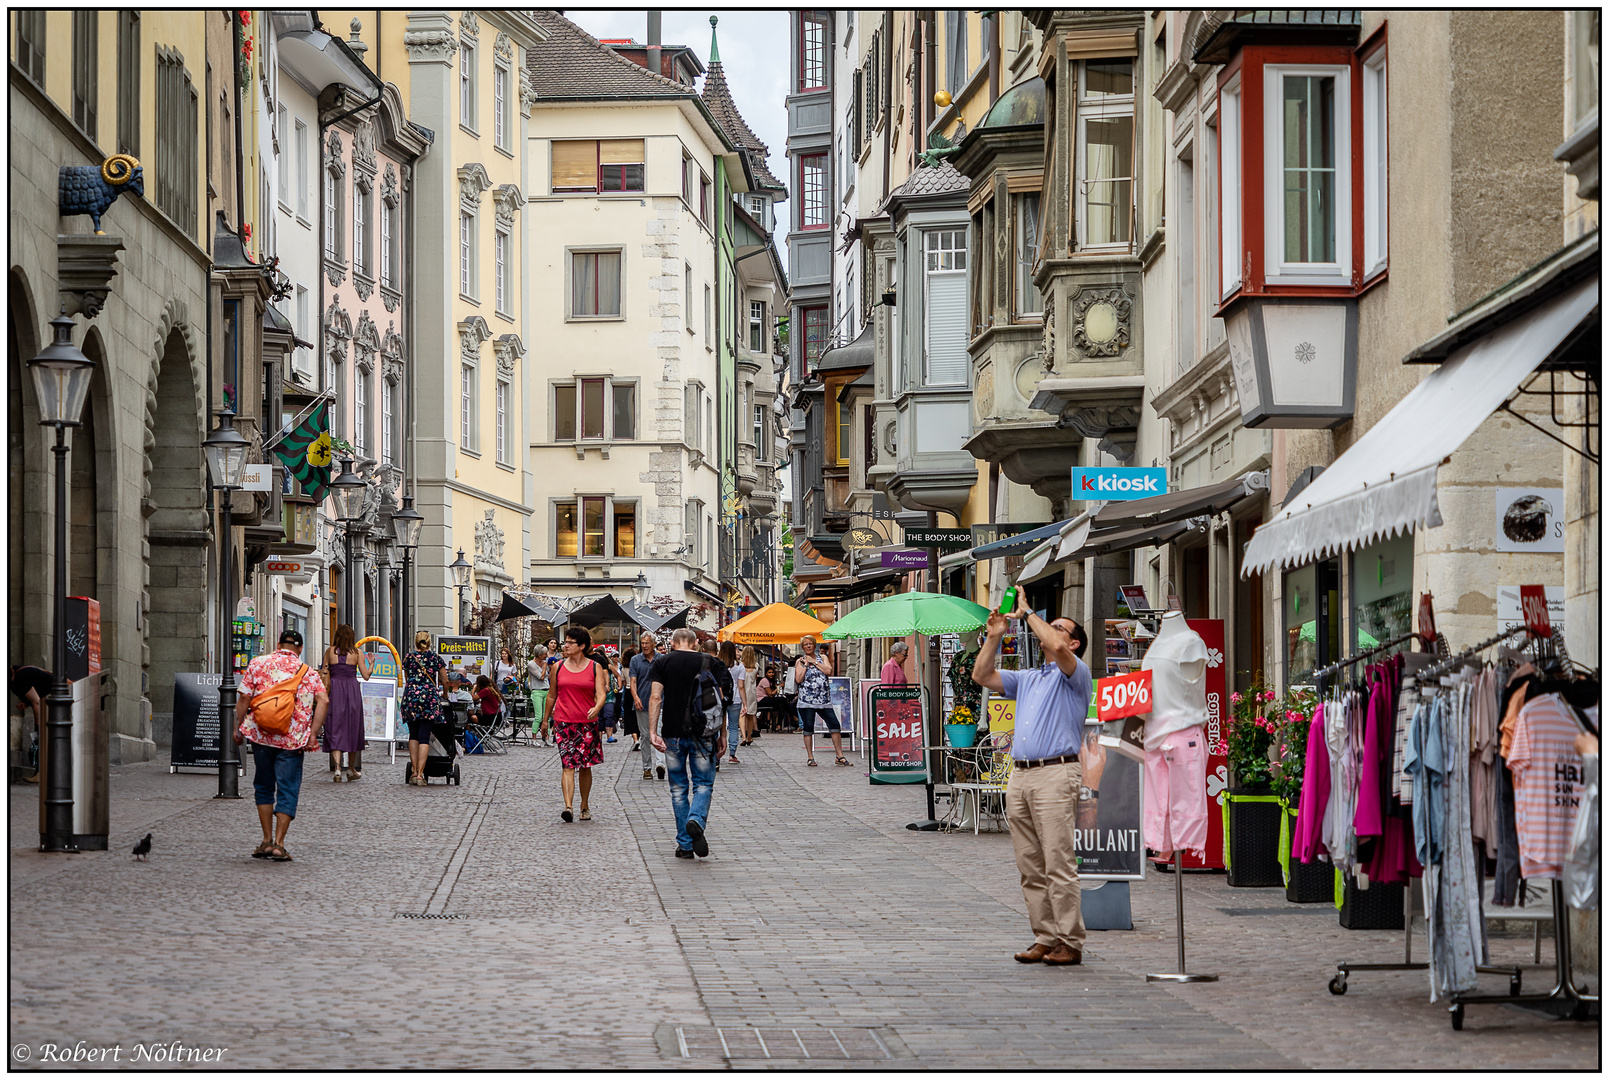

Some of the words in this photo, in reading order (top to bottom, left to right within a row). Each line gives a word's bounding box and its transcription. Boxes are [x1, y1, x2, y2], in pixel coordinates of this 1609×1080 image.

[1081, 474, 1095, 491] k
[1098, 473, 1158, 492] kiosk
[906, 533, 922, 541] THE
[924, 533, 948, 541] BODY
[267, 562, 301, 573] coop
[1522, 595, 1549, 627] 50%
[440, 641, 486, 653] Preis-Hits!
[1100, 678, 1149, 712] 50%
[876, 721, 922, 739] SALE
[1207, 692, 1220, 756] SWISSLOS
